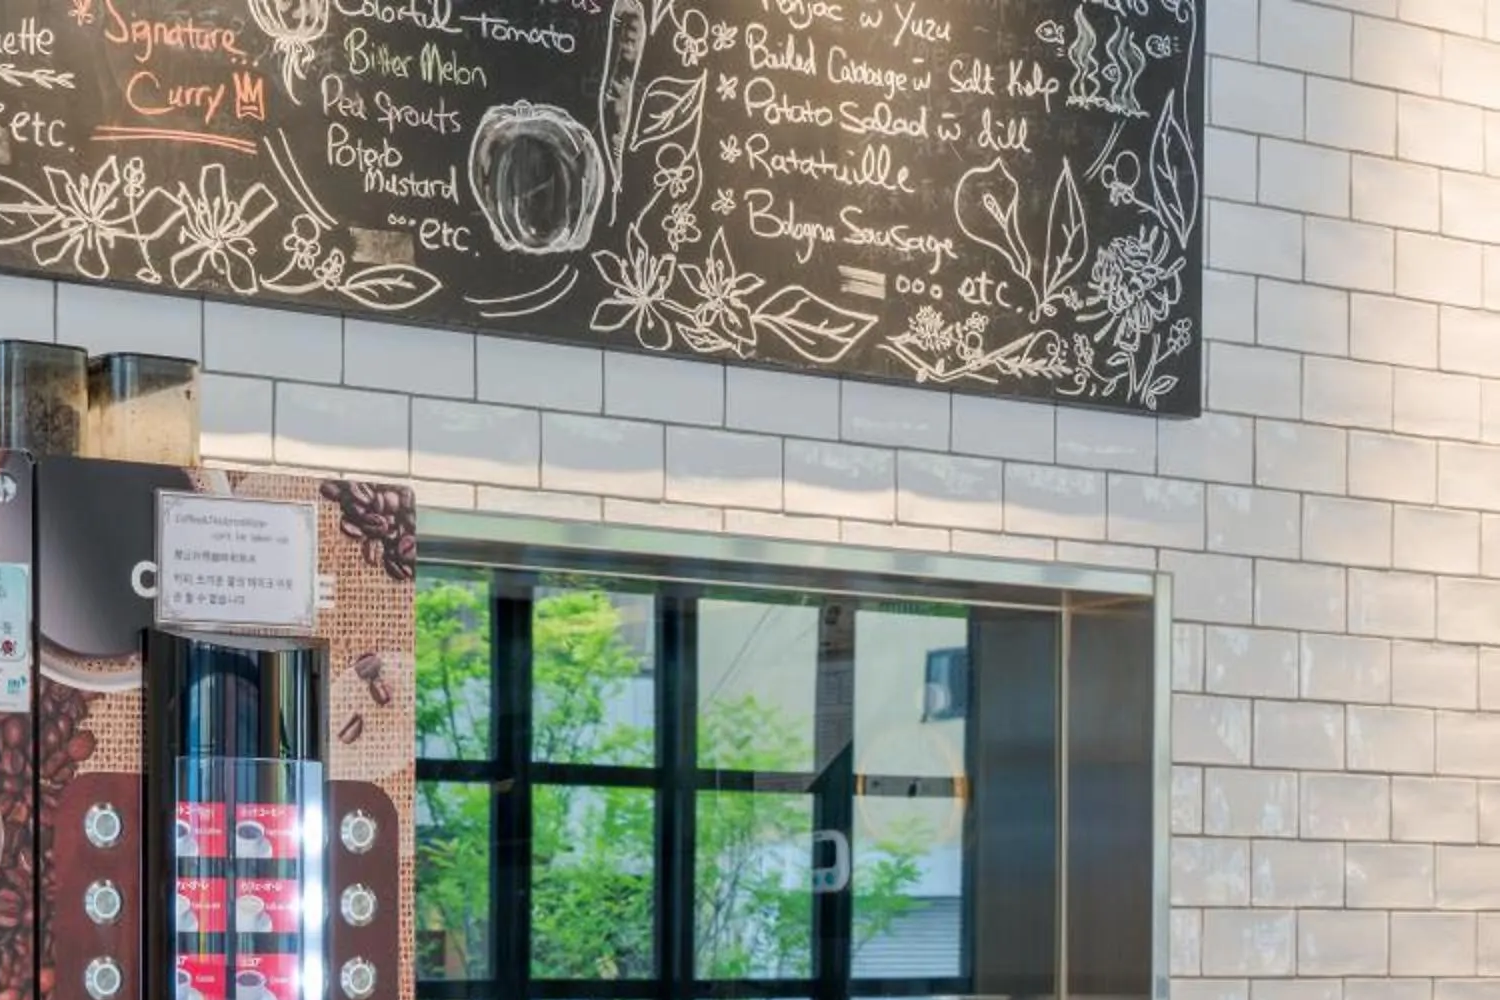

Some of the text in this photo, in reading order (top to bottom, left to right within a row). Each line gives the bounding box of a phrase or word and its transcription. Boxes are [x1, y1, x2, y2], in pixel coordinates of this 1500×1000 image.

[104, 0, 244, 62] Signature
[763, 0, 844, 29] onjac
[894, 2, 951, 47] Yuzu
[419, 42, 488, 88] Melon
[949, 58, 996, 96] Salt
[126, 71, 225, 124] Curry
[321, 74, 368, 121] Pea
[744, 77, 833, 125] Potato
[839, 101, 929, 139] Salad
[9, 110, 75, 153] etc.
[364, 164, 460, 205] Mustard
[418, 217, 480, 258] etc.
[839, 205, 959, 275] Sausage
[957, 271, 1024, 314] etc.
